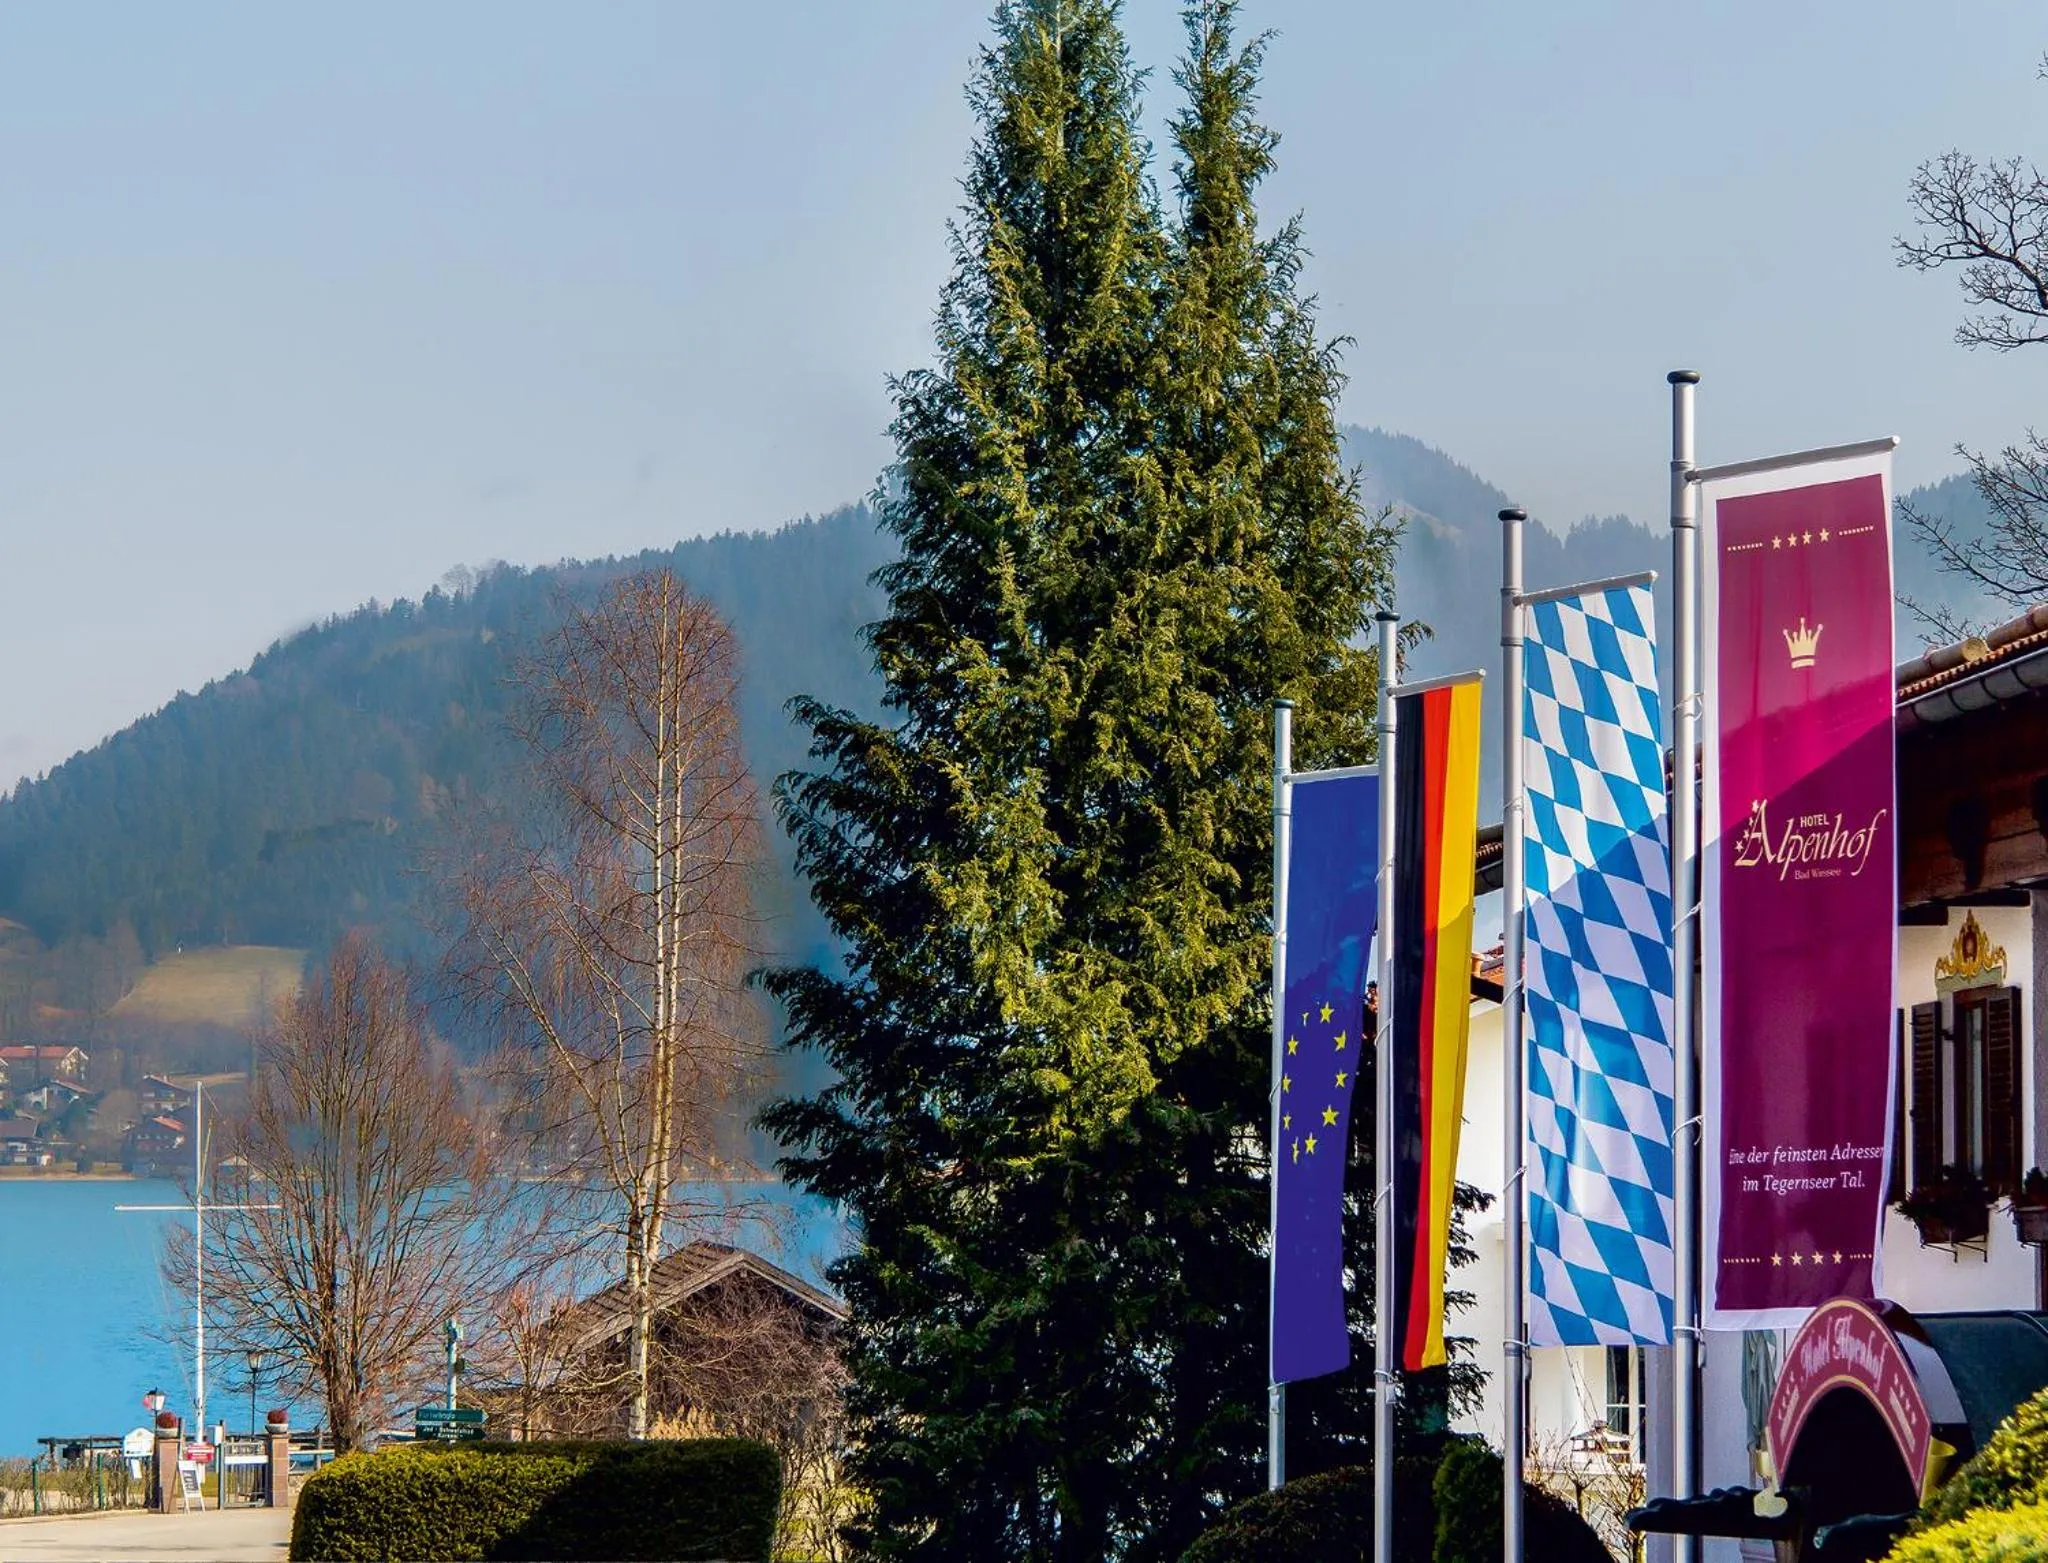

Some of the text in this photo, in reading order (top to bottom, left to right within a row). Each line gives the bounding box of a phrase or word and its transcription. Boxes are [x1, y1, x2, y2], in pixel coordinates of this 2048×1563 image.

[1800, 813, 1830, 828] HOTEL
[1734, 799, 1887, 882] Alpenhof
[1794, 869, 1810, 880] Bad
[1747, 1146, 1769, 1164] der
[1772, 1145, 1827, 1166] feinsten
[1743, 1170, 1866, 1195] im Tegernseer Tal.
